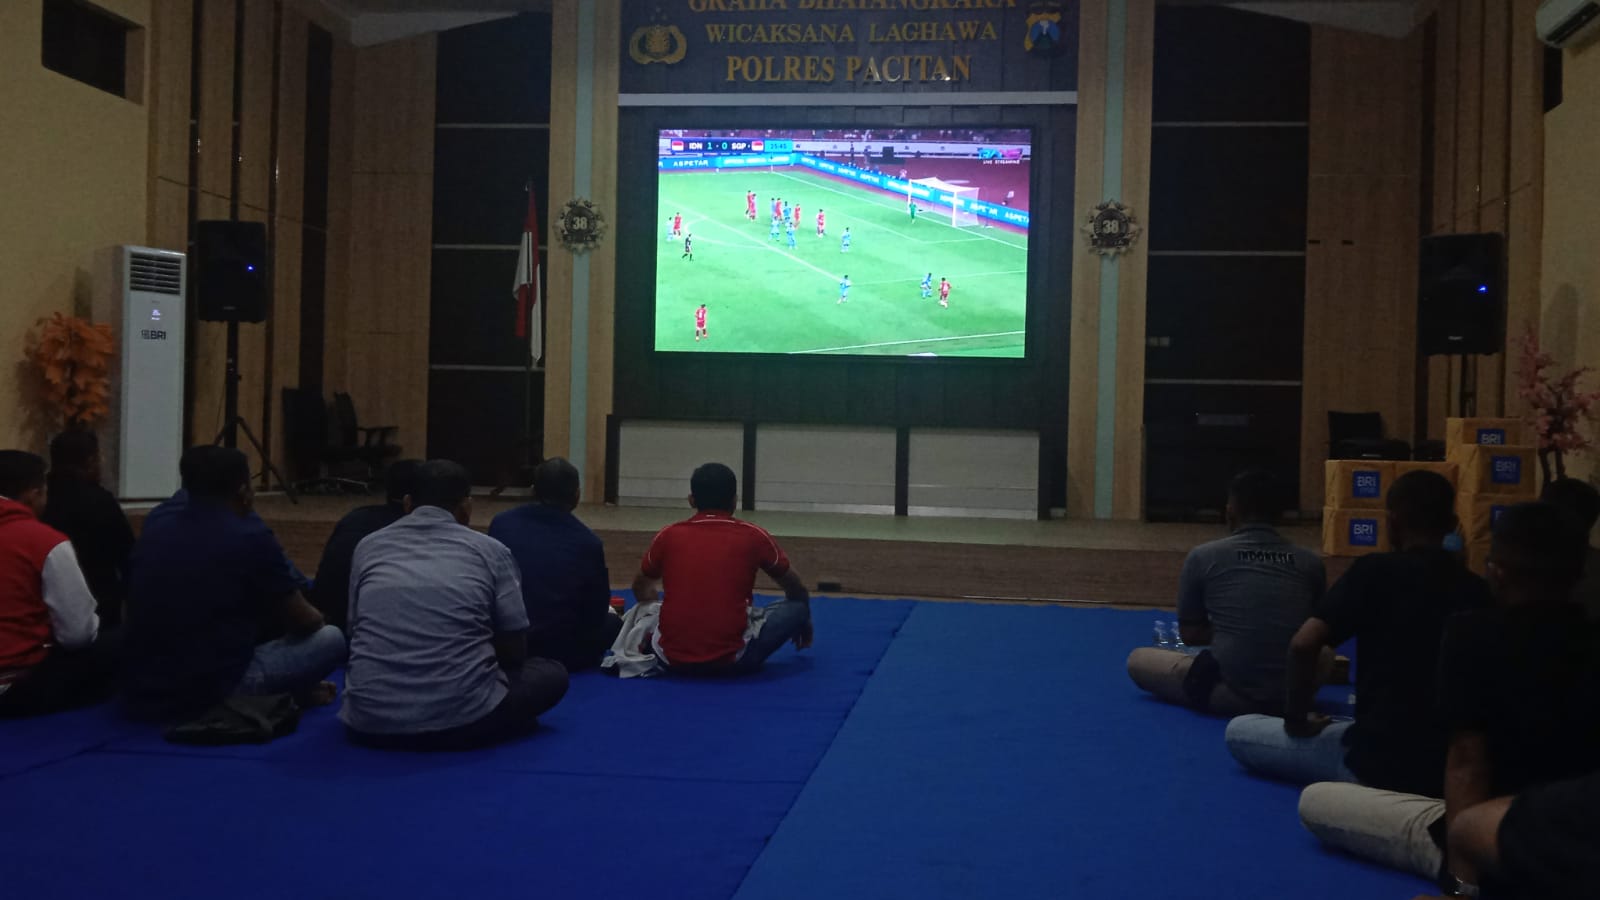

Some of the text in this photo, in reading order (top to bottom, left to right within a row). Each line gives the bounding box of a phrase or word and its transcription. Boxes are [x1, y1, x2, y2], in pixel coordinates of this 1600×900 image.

[705, 22, 997, 43] WICAKSANA LAGHAWA
[725, 54, 971, 82] POLRES PACITAN
[688, 142, 703, 150] IDN
[707, 142, 713, 150] 1
[721, 142, 728, 150] 0
[731, 142, 747, 150] SGP
[573, 216, 588, 230] 38
[1102, 219, 1119, 234] 38
[150, 329, 167, 340] BRI
[1481, 433, 1502, 445] BRI
[1495, 460, 1517, 472] BRI
[1357, 476, 1377, 487] BRI
[1353, 523, 1374, 535] BRI
